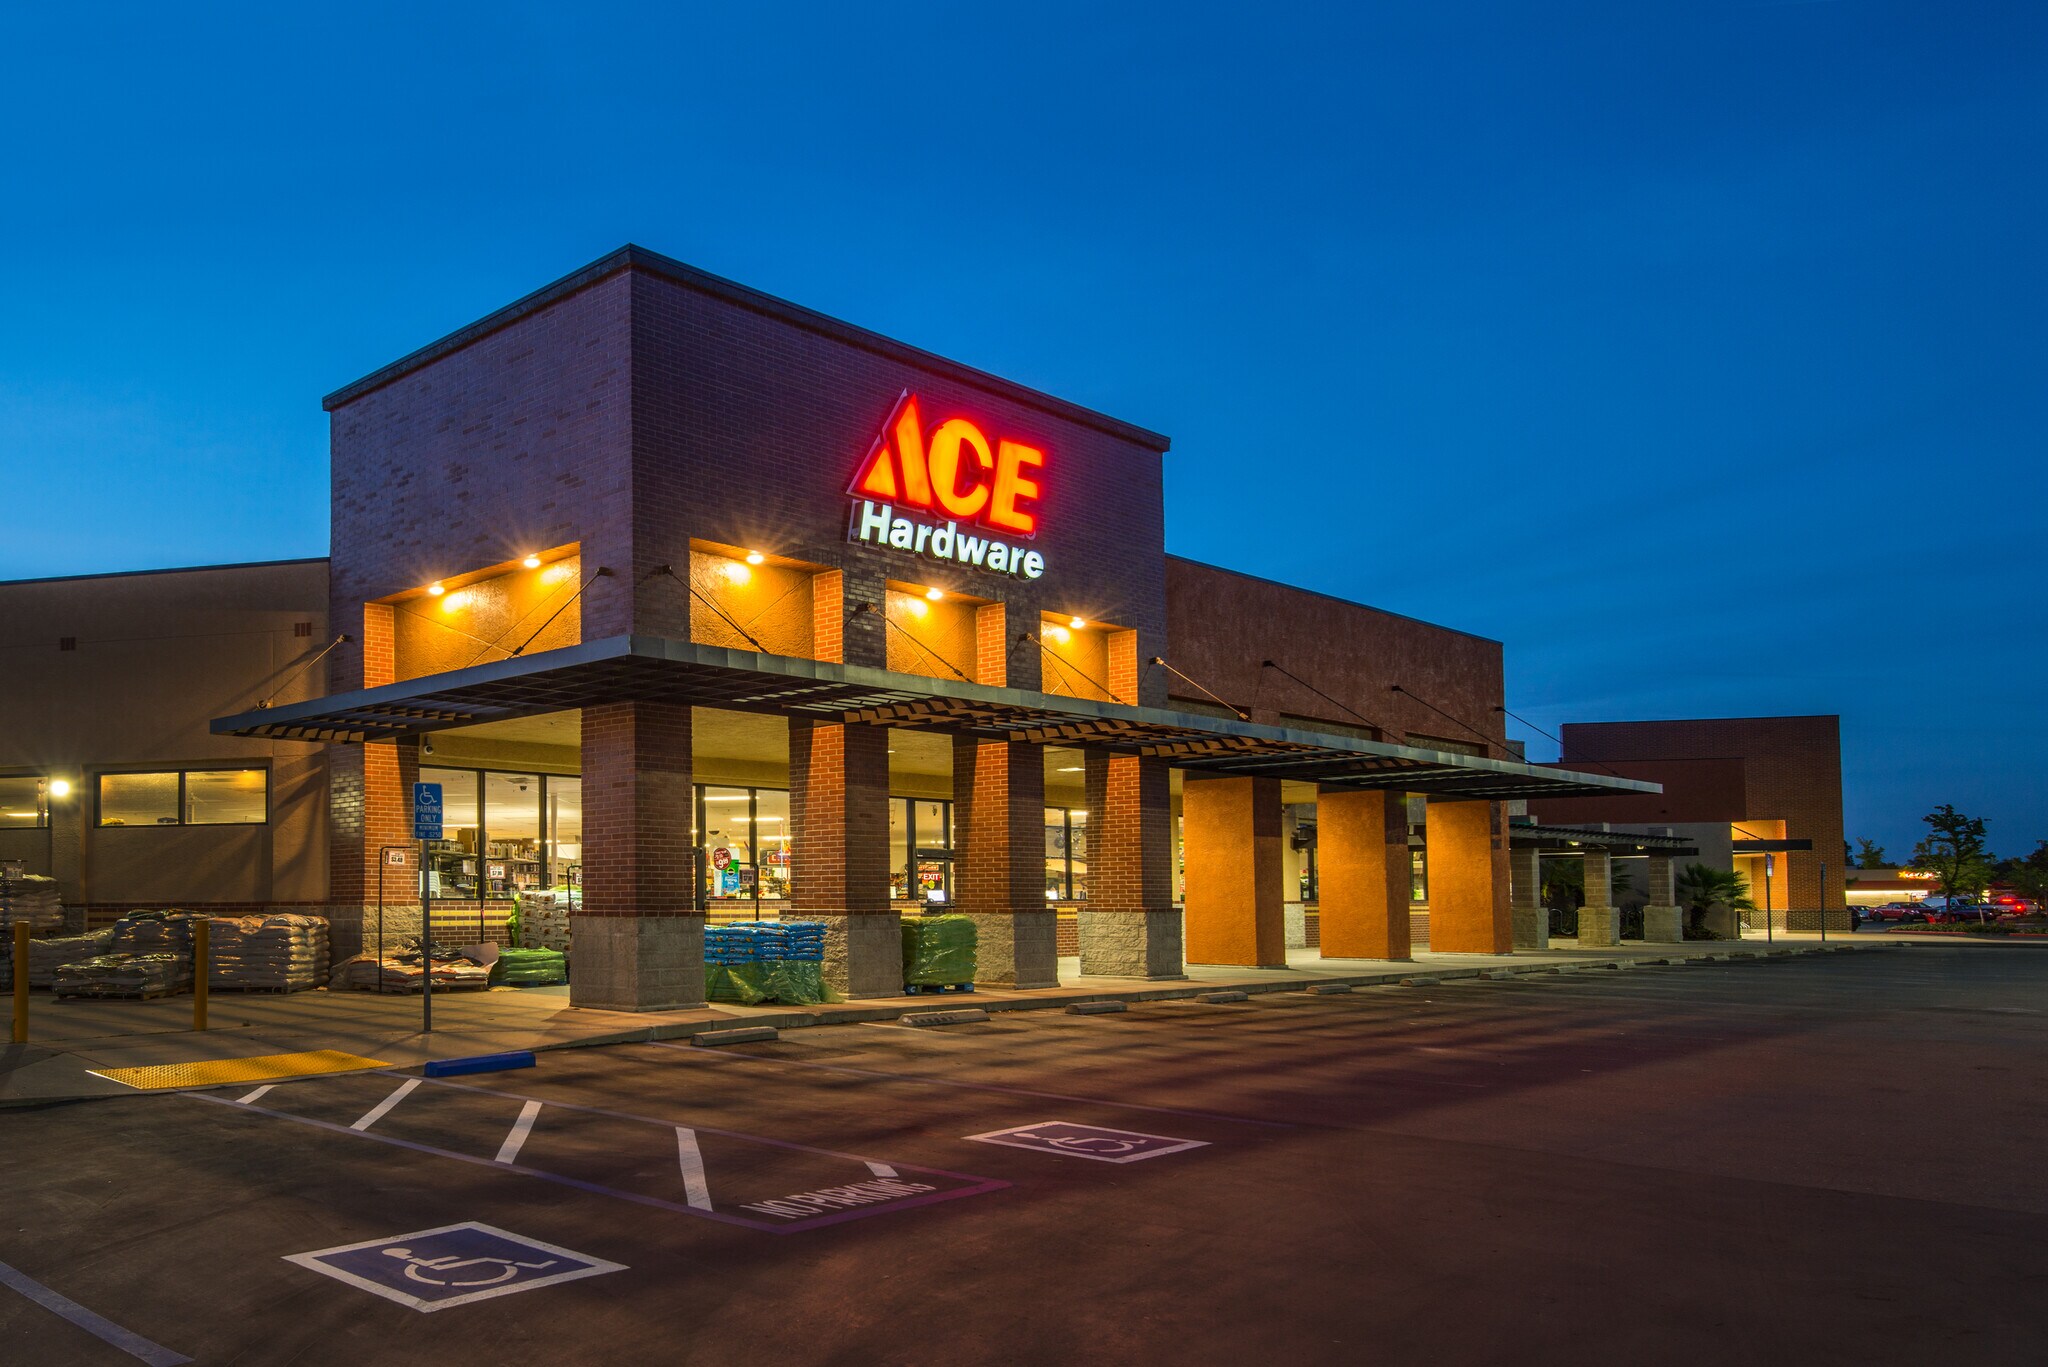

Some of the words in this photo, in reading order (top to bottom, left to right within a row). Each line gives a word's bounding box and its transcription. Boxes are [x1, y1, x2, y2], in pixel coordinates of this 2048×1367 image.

[860, 393, 1045, 533] ACE
[859, 500, 1045, 579] Hardware
[415, 805, 441, 814] PARKING
[420, 814, 437, 822] ONLY
[740, 1199, 823, 1219] NO
[785, 1179, 936, 1210] PARKING
